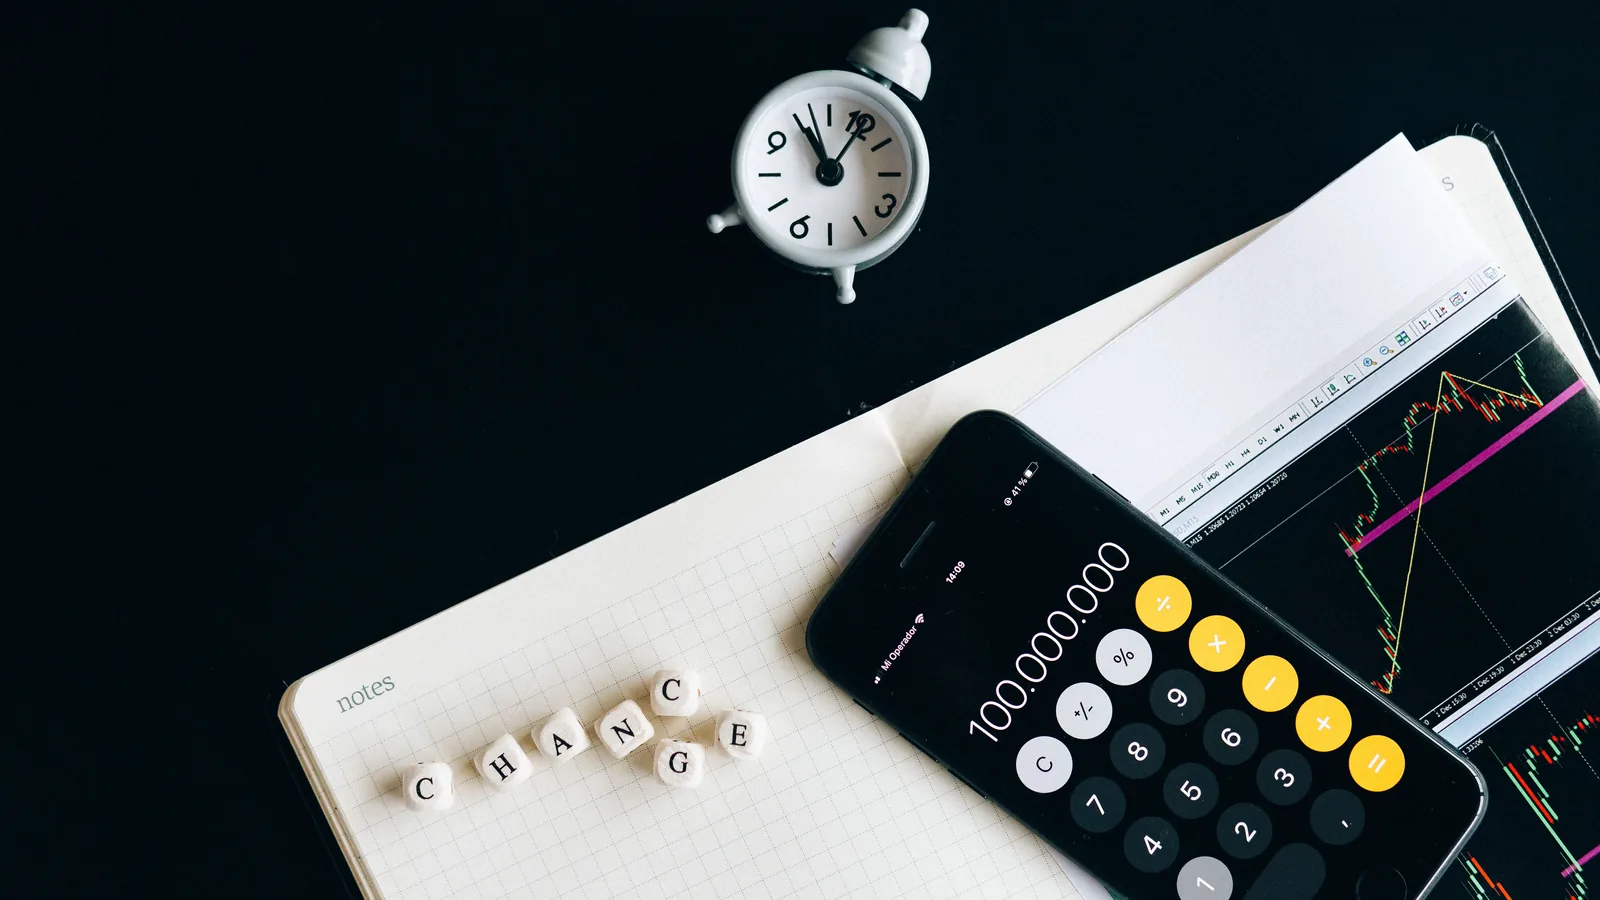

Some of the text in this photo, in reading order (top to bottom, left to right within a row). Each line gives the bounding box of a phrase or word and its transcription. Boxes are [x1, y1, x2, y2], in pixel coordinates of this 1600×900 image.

[845, 109, 876, 142] 12
[768, 131, 786, 155] 9
[875, 193, 897, 218] 3
[789, 215, 811, 239] 6
[1160, 508, 1170, 517] M1
[1191, 482, 1204, 494] M15
[1225, 460, 1235, 469] H1
[1241, 448, 1251, 458] H4
[1258, 436, 1267, 446] D1
[1273, 424, 1285, 433] W1
[946, 561, 965, 584] 14:09
[881, 625, 917, 671] Mi Operador
[969, 542, 1129, 742] 100.000.000
[1515, 650, 1527, 661] Dec
[1477, 677, 1489, 687] Dec
[1489, 666, 1505, 680] 19:30
[337, 676, 395, 713] notes
[1168, 688, 1187, 708] 9
[1440, 704, 1452, 714] Dec
[1451, 692, 1467, 706] 15:30
[1221, 728, 1241, 747] 6
[1128, 742, 1148, 761] 8
[1036, 756, 1053, 773] C
[1274, 768, 1294, 787] 3
[1180, 781, 1202, 801] 5
[1086, 794, 1105, 816] 7
[1235, 822, 1257, 842] 2
[1144, 835, 1163, 855] 4
[1196, 876, 1215, 891] 1
